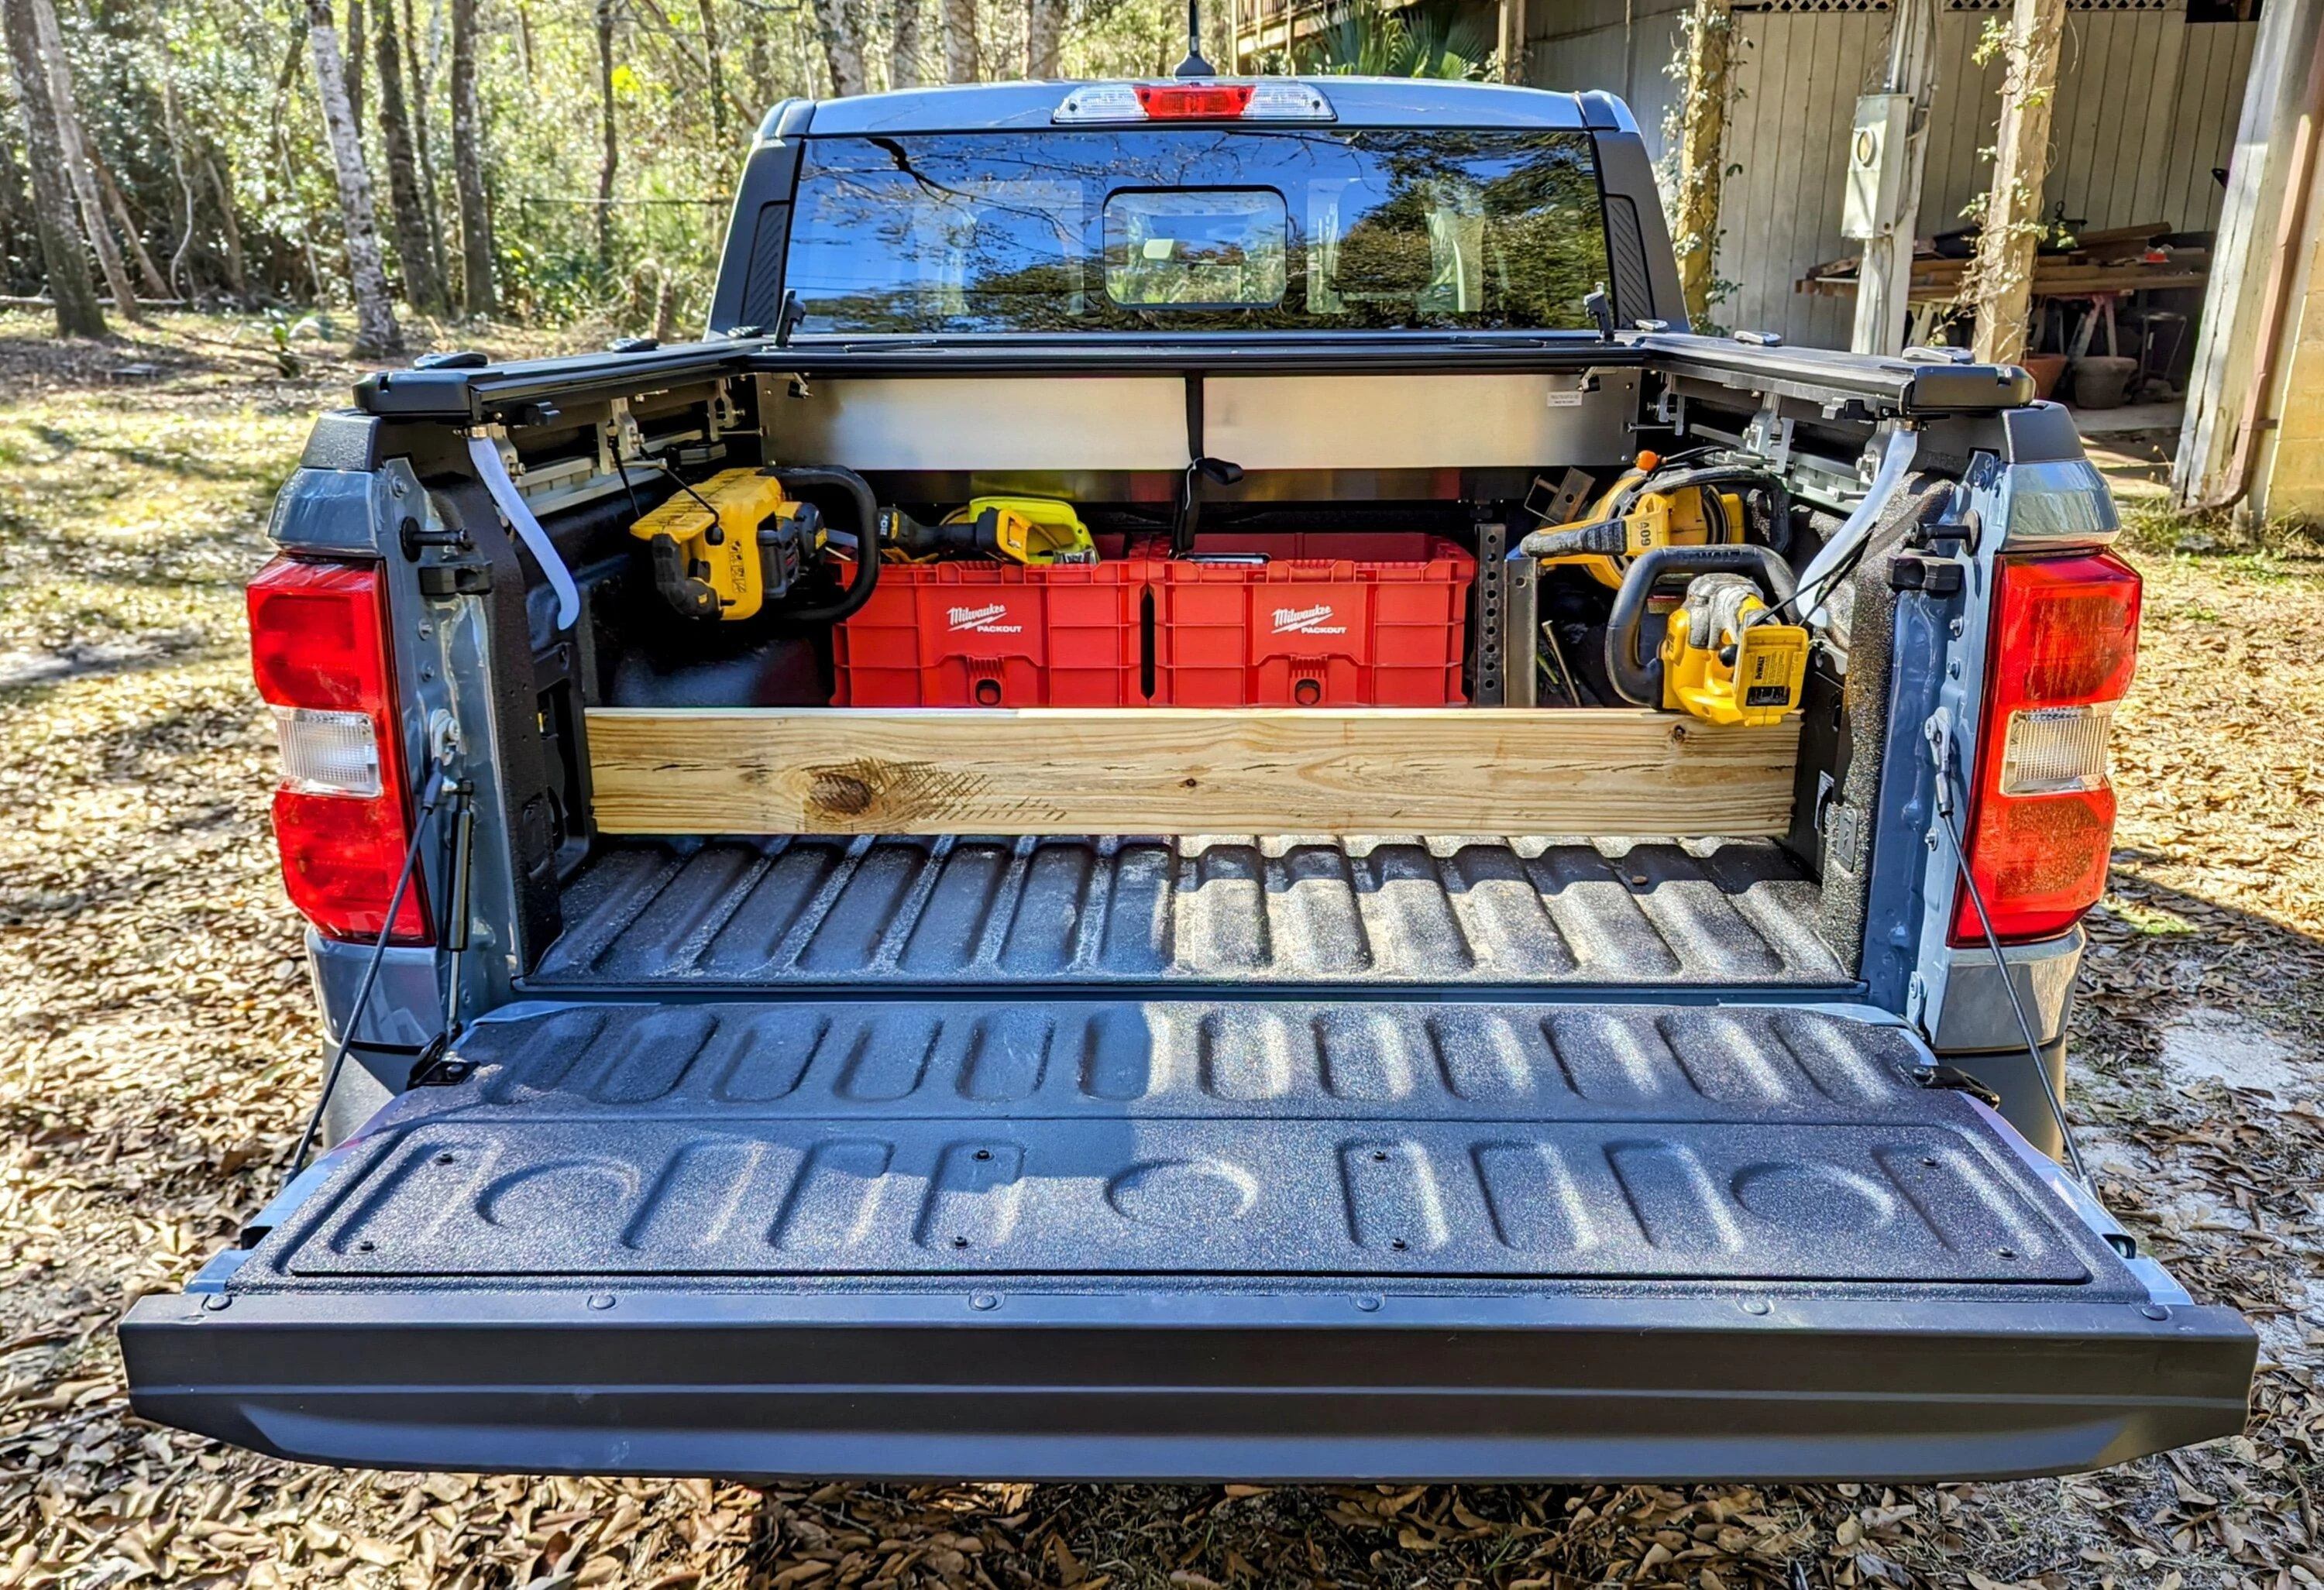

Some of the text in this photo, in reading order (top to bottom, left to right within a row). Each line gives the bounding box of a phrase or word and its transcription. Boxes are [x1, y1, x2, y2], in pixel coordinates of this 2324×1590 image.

[1640, 521, 1651, 547] 60V
[946, 603, 1006, 626] Milwaukee
[1270, 604, 1332, 627] Milwaukee
